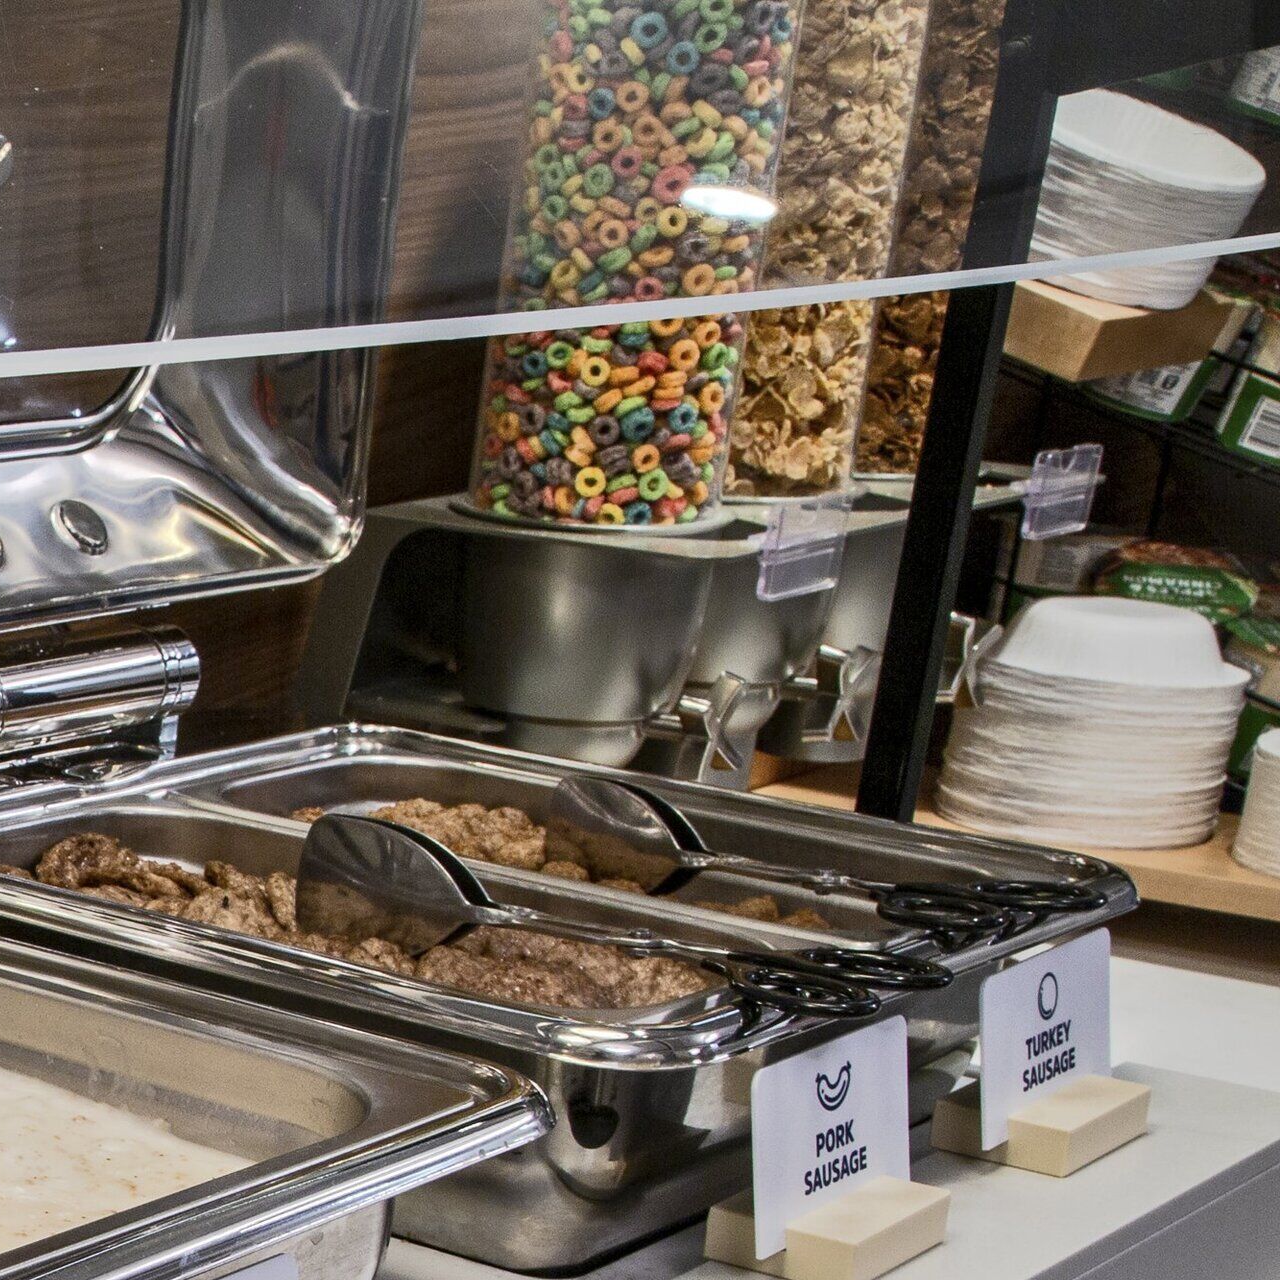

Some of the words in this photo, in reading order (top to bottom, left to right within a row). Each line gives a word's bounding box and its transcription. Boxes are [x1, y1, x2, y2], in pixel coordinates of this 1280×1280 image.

[1025, 1018, 1072, 1061] TURKEY
[1022, 1046, 1076, 1092] SAUSAGE
[815, 1118, 855, 1158] PORK
[803, 1145, 868, 1196] SAUSAGE
